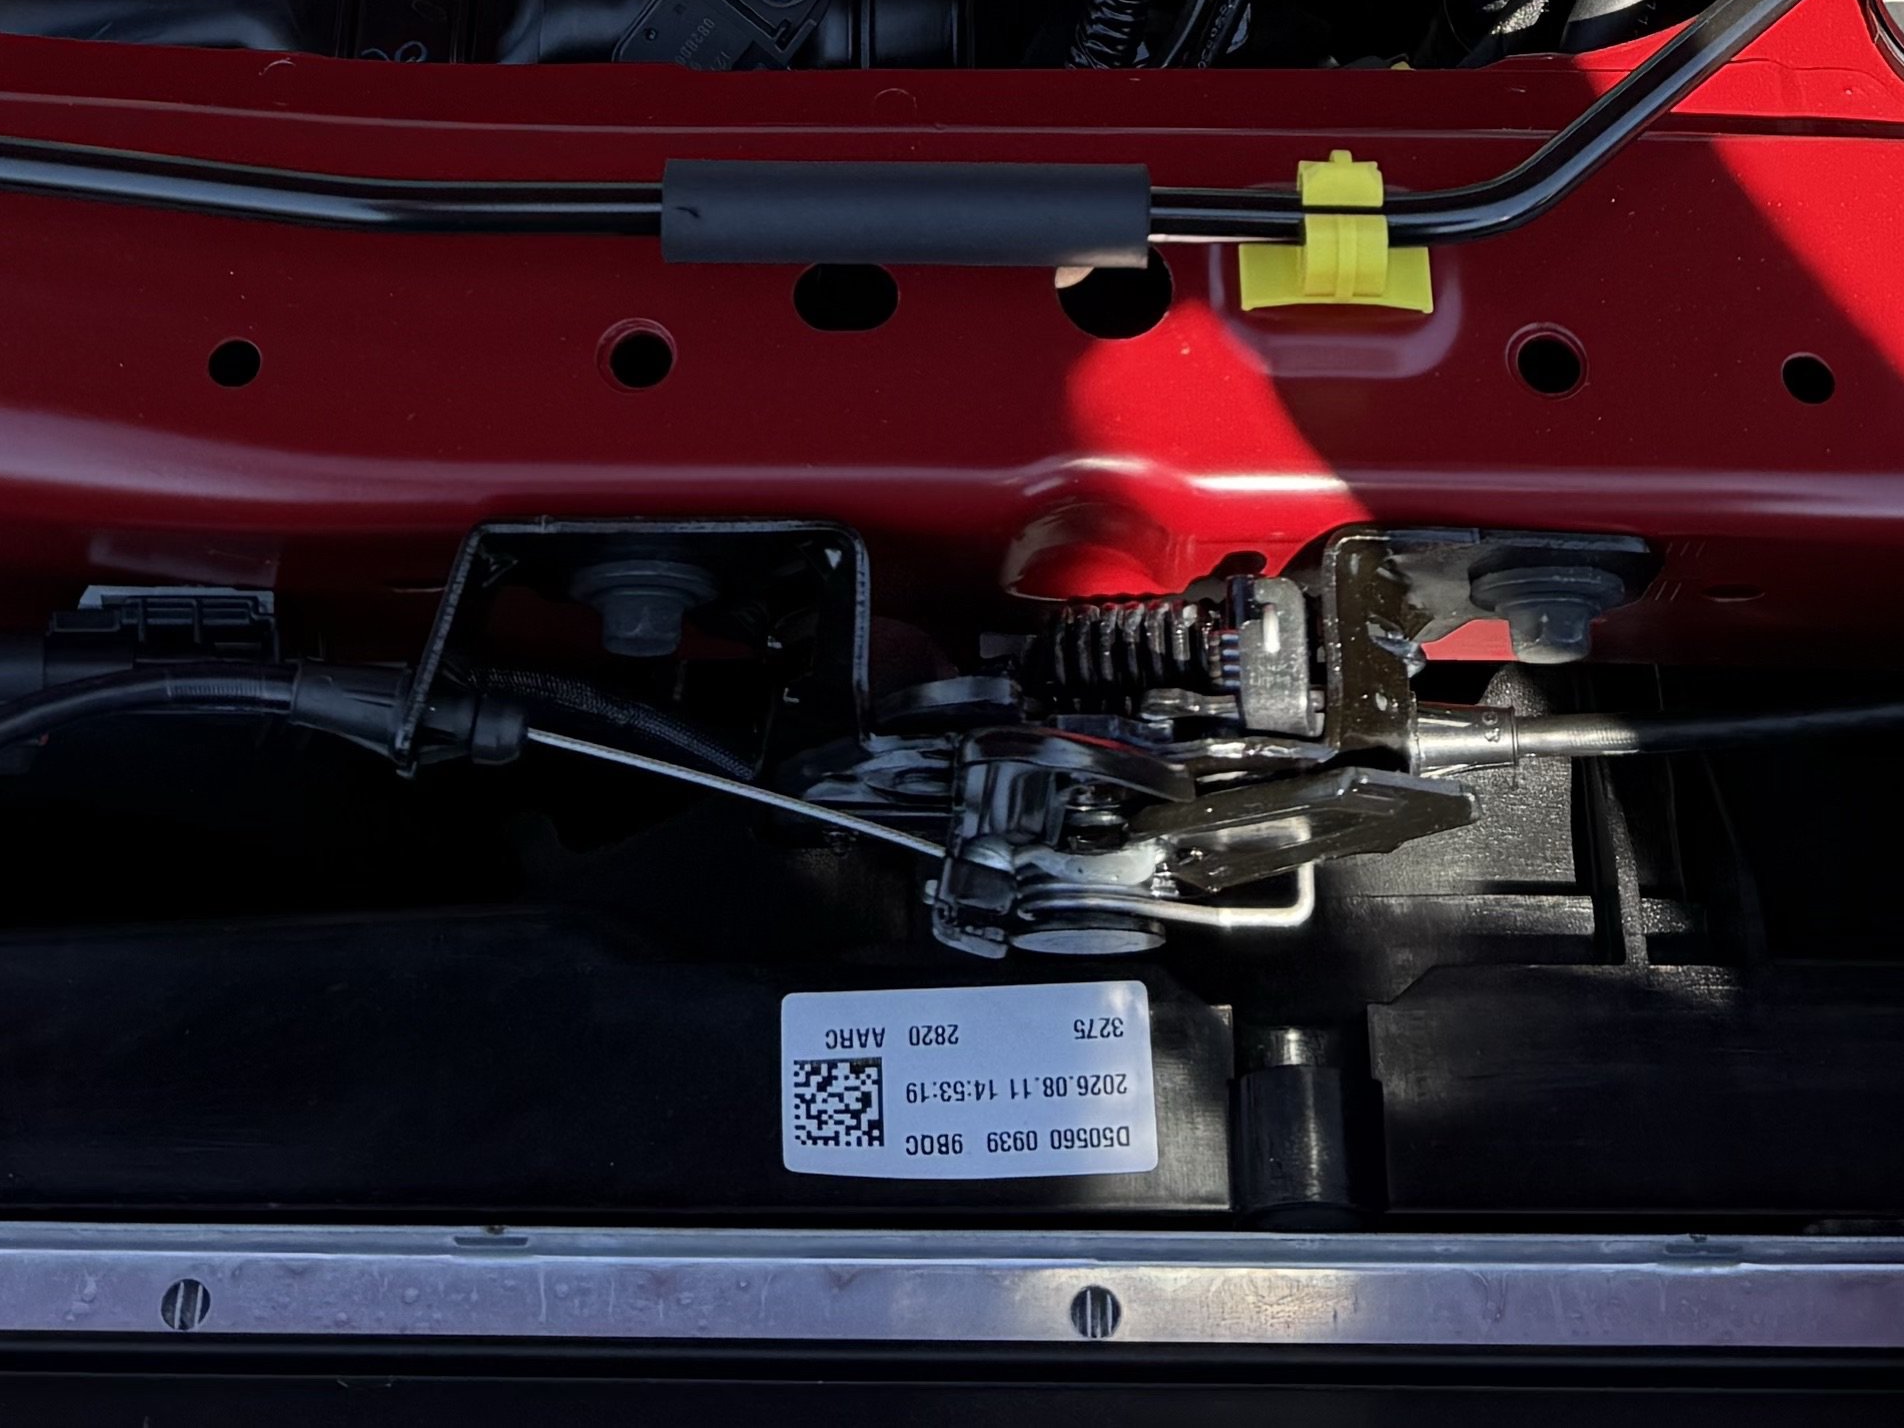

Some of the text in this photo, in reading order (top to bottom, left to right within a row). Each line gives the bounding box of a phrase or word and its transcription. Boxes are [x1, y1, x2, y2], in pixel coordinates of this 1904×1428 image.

[825, 1017, 1124, 1049] 3275 2820 AARC
[906, 1072, 1128, 1104] 2026.08.11 14:53:19
[986, 1130, 1038, 1153] 0939
[1050, 1126, 1130, 1148] D50560
